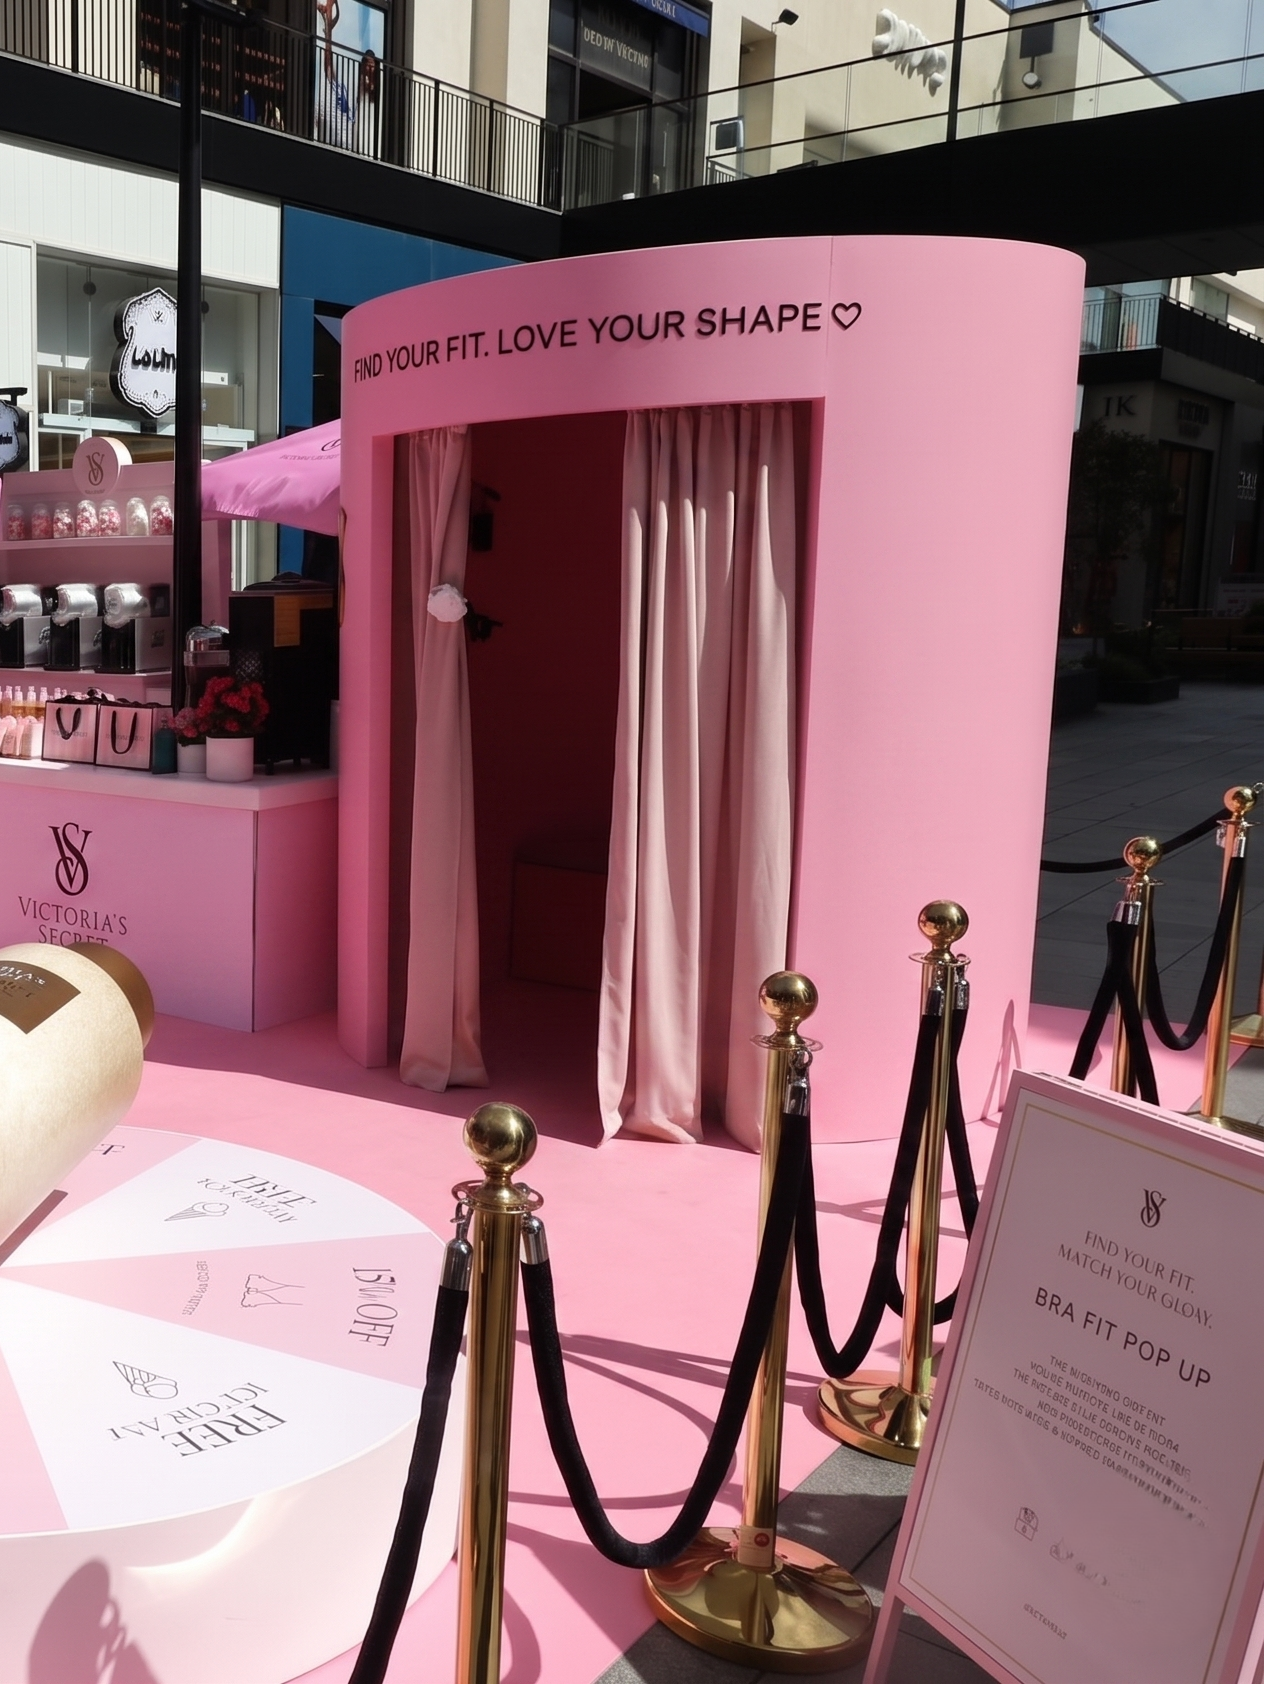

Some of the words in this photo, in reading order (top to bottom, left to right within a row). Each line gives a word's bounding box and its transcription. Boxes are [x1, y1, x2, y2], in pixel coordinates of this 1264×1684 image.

[354, 353, 383, 384] FIND
[387, 340, 440, 373] YOUR
[447, 331, 490, 363] FIT.
[498, 319, 578, 355] LOVE
[588, 310, 685, 345] YOUR
[696, 302, 823, 337] SHAPE
[18, 895, 128, 936] VICTORIA'S
[1057, 1243, 1112, 1280] MATCH
[1116, 1263, 1158, 1301] YOUR
[1084, 1229, 1120, 1258] FIND
[1124, 1246, 1166, 1279] YOUR
[1170, 1268, 1196, 1294] FIT.
[1034, 1286, 1075, 1323] BRA
[1082, 1310, 1118, 1342] FIT
[1123, 1331, 1171, 1368] POP
[1178, 1357, 1212, 1389] UP
[161, 1404, 287, 1457] FREE
